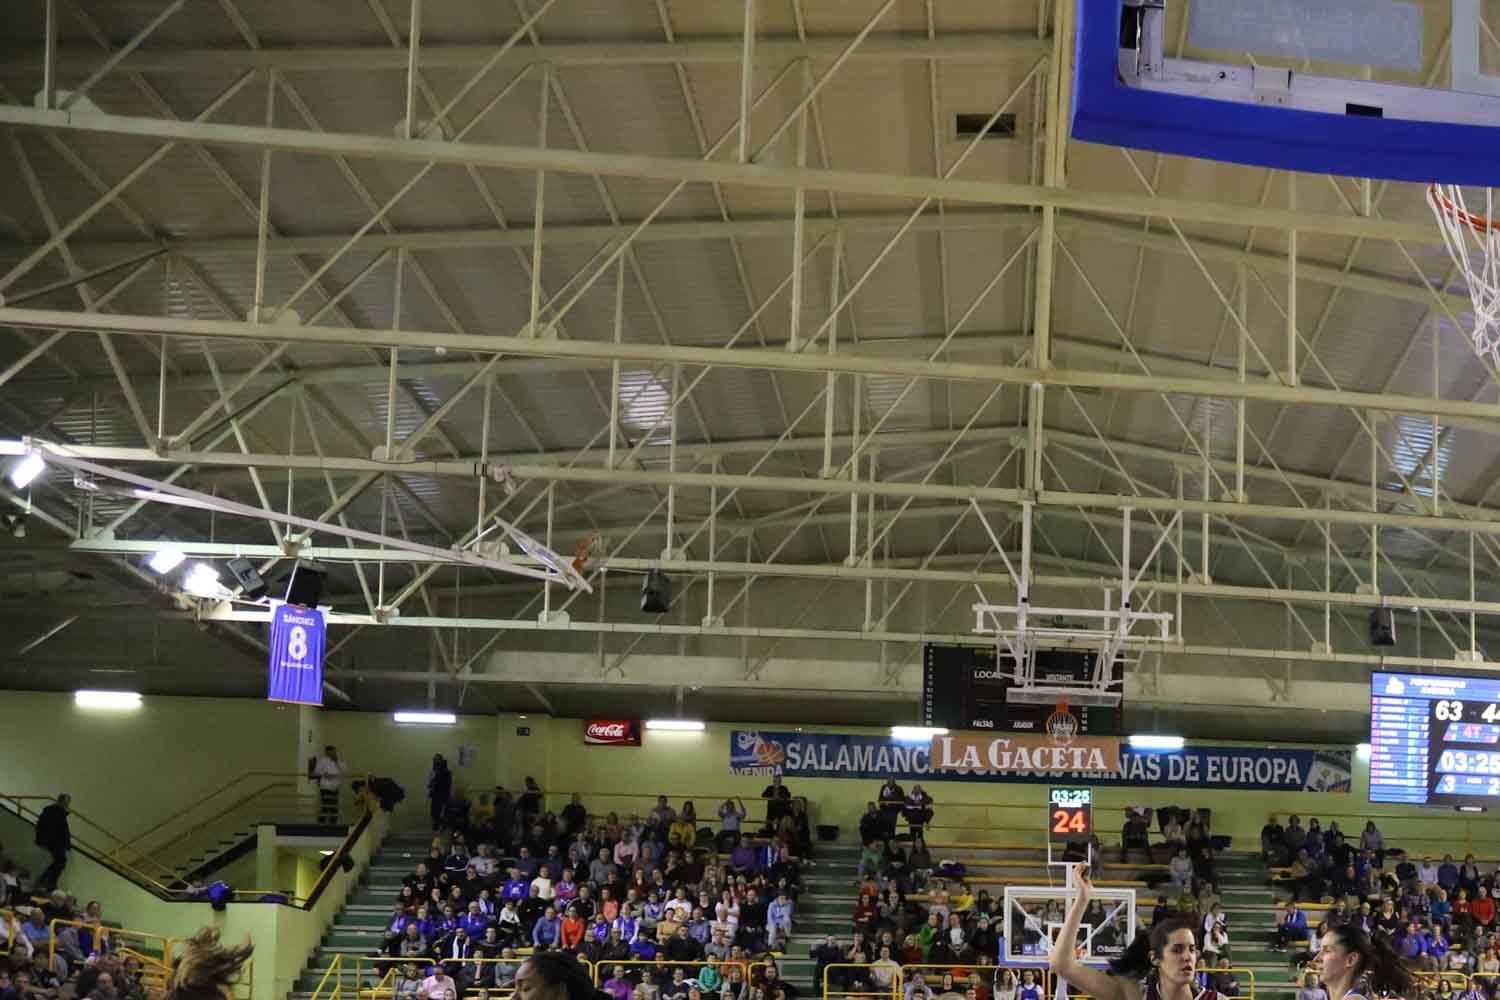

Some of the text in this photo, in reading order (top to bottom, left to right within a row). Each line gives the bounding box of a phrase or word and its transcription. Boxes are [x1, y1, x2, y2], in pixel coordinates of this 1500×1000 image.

[288, 626, 307, 660] 8
[1436, 700, 1463, 720] 63
[786, 742, 952, 776] SALAMANC
[1167, 755, 1200, 782] DE
[1206, 756, 1302, 785] EUROPA
[940, 736, 1107, 770] LA GACETA
[1051, 790, 1090, 803] 03:25
[1443, 775, 1456, 792] 3
[1487, 777, 1500, 795] 2
[1053, 810, 1086, 833] 24
